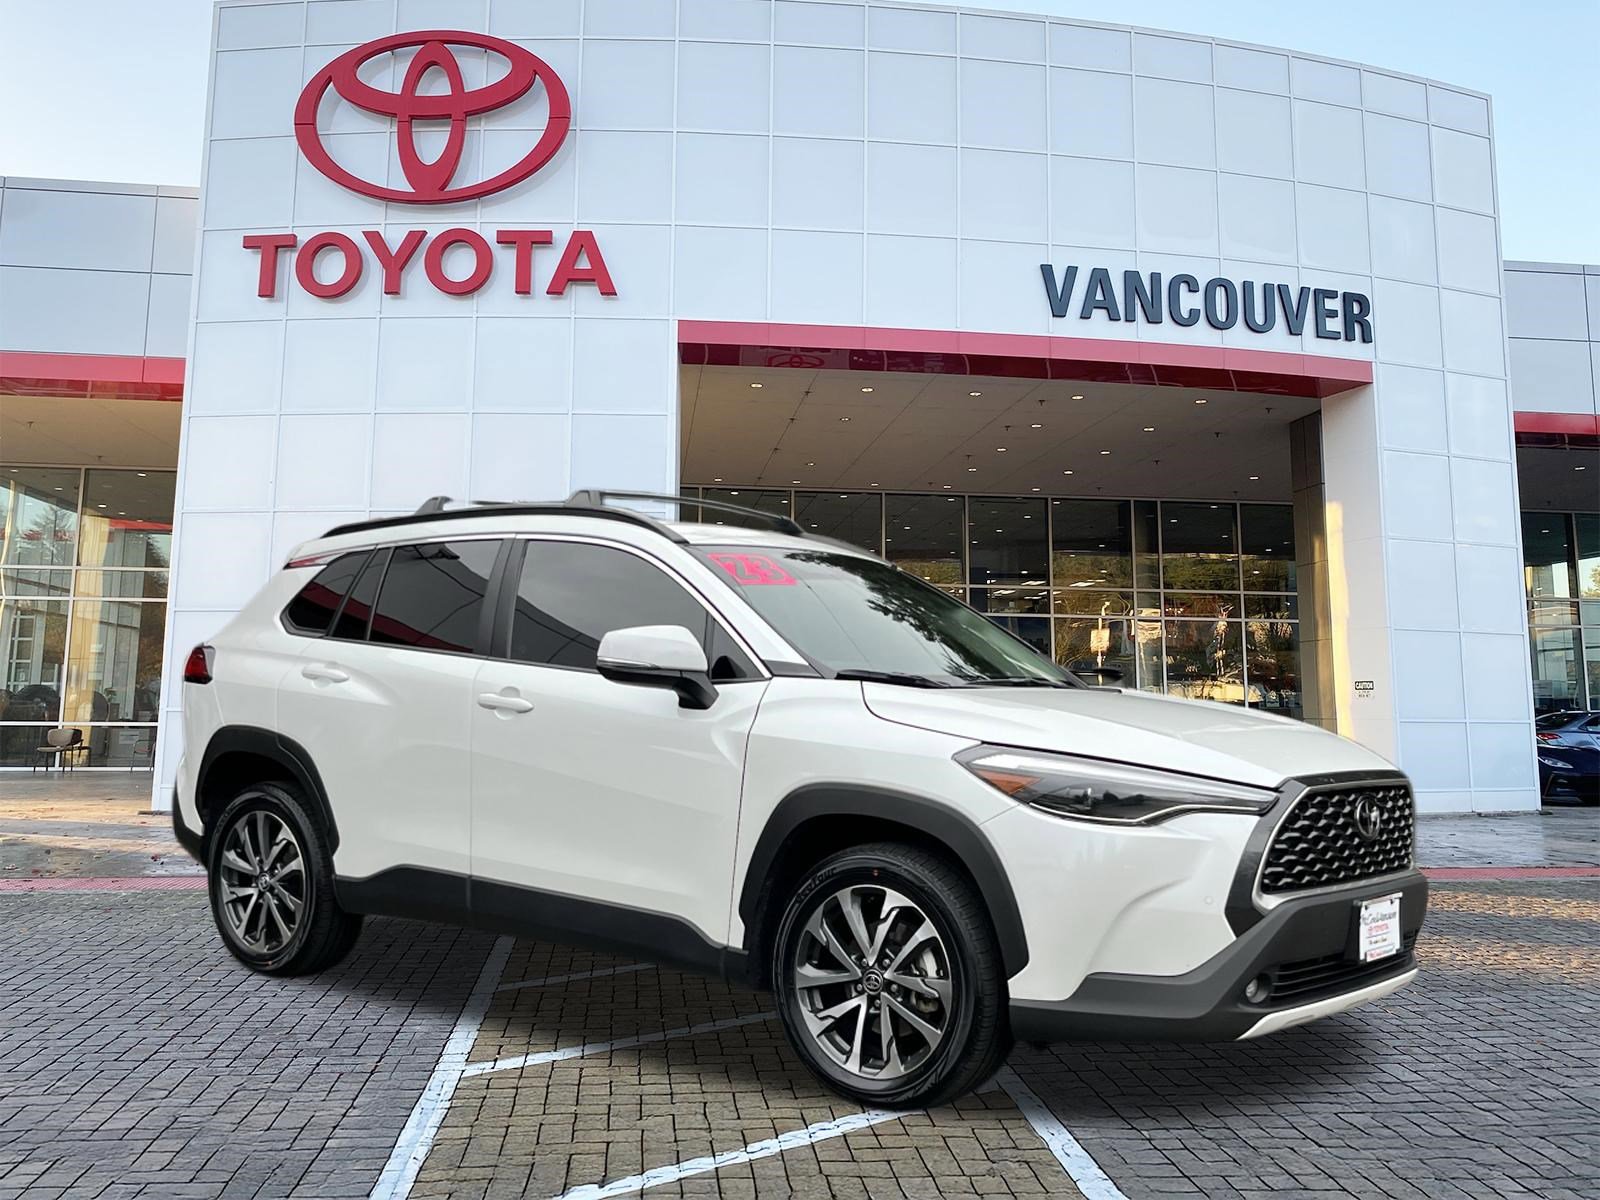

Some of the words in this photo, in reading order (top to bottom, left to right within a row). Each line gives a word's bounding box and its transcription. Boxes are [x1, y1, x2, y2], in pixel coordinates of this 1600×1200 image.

[243, 228, 617, 298] TOYOTA
[1040, 264, 1373, 343] VANCOUVER
[715, 555, 789, 580] 23
